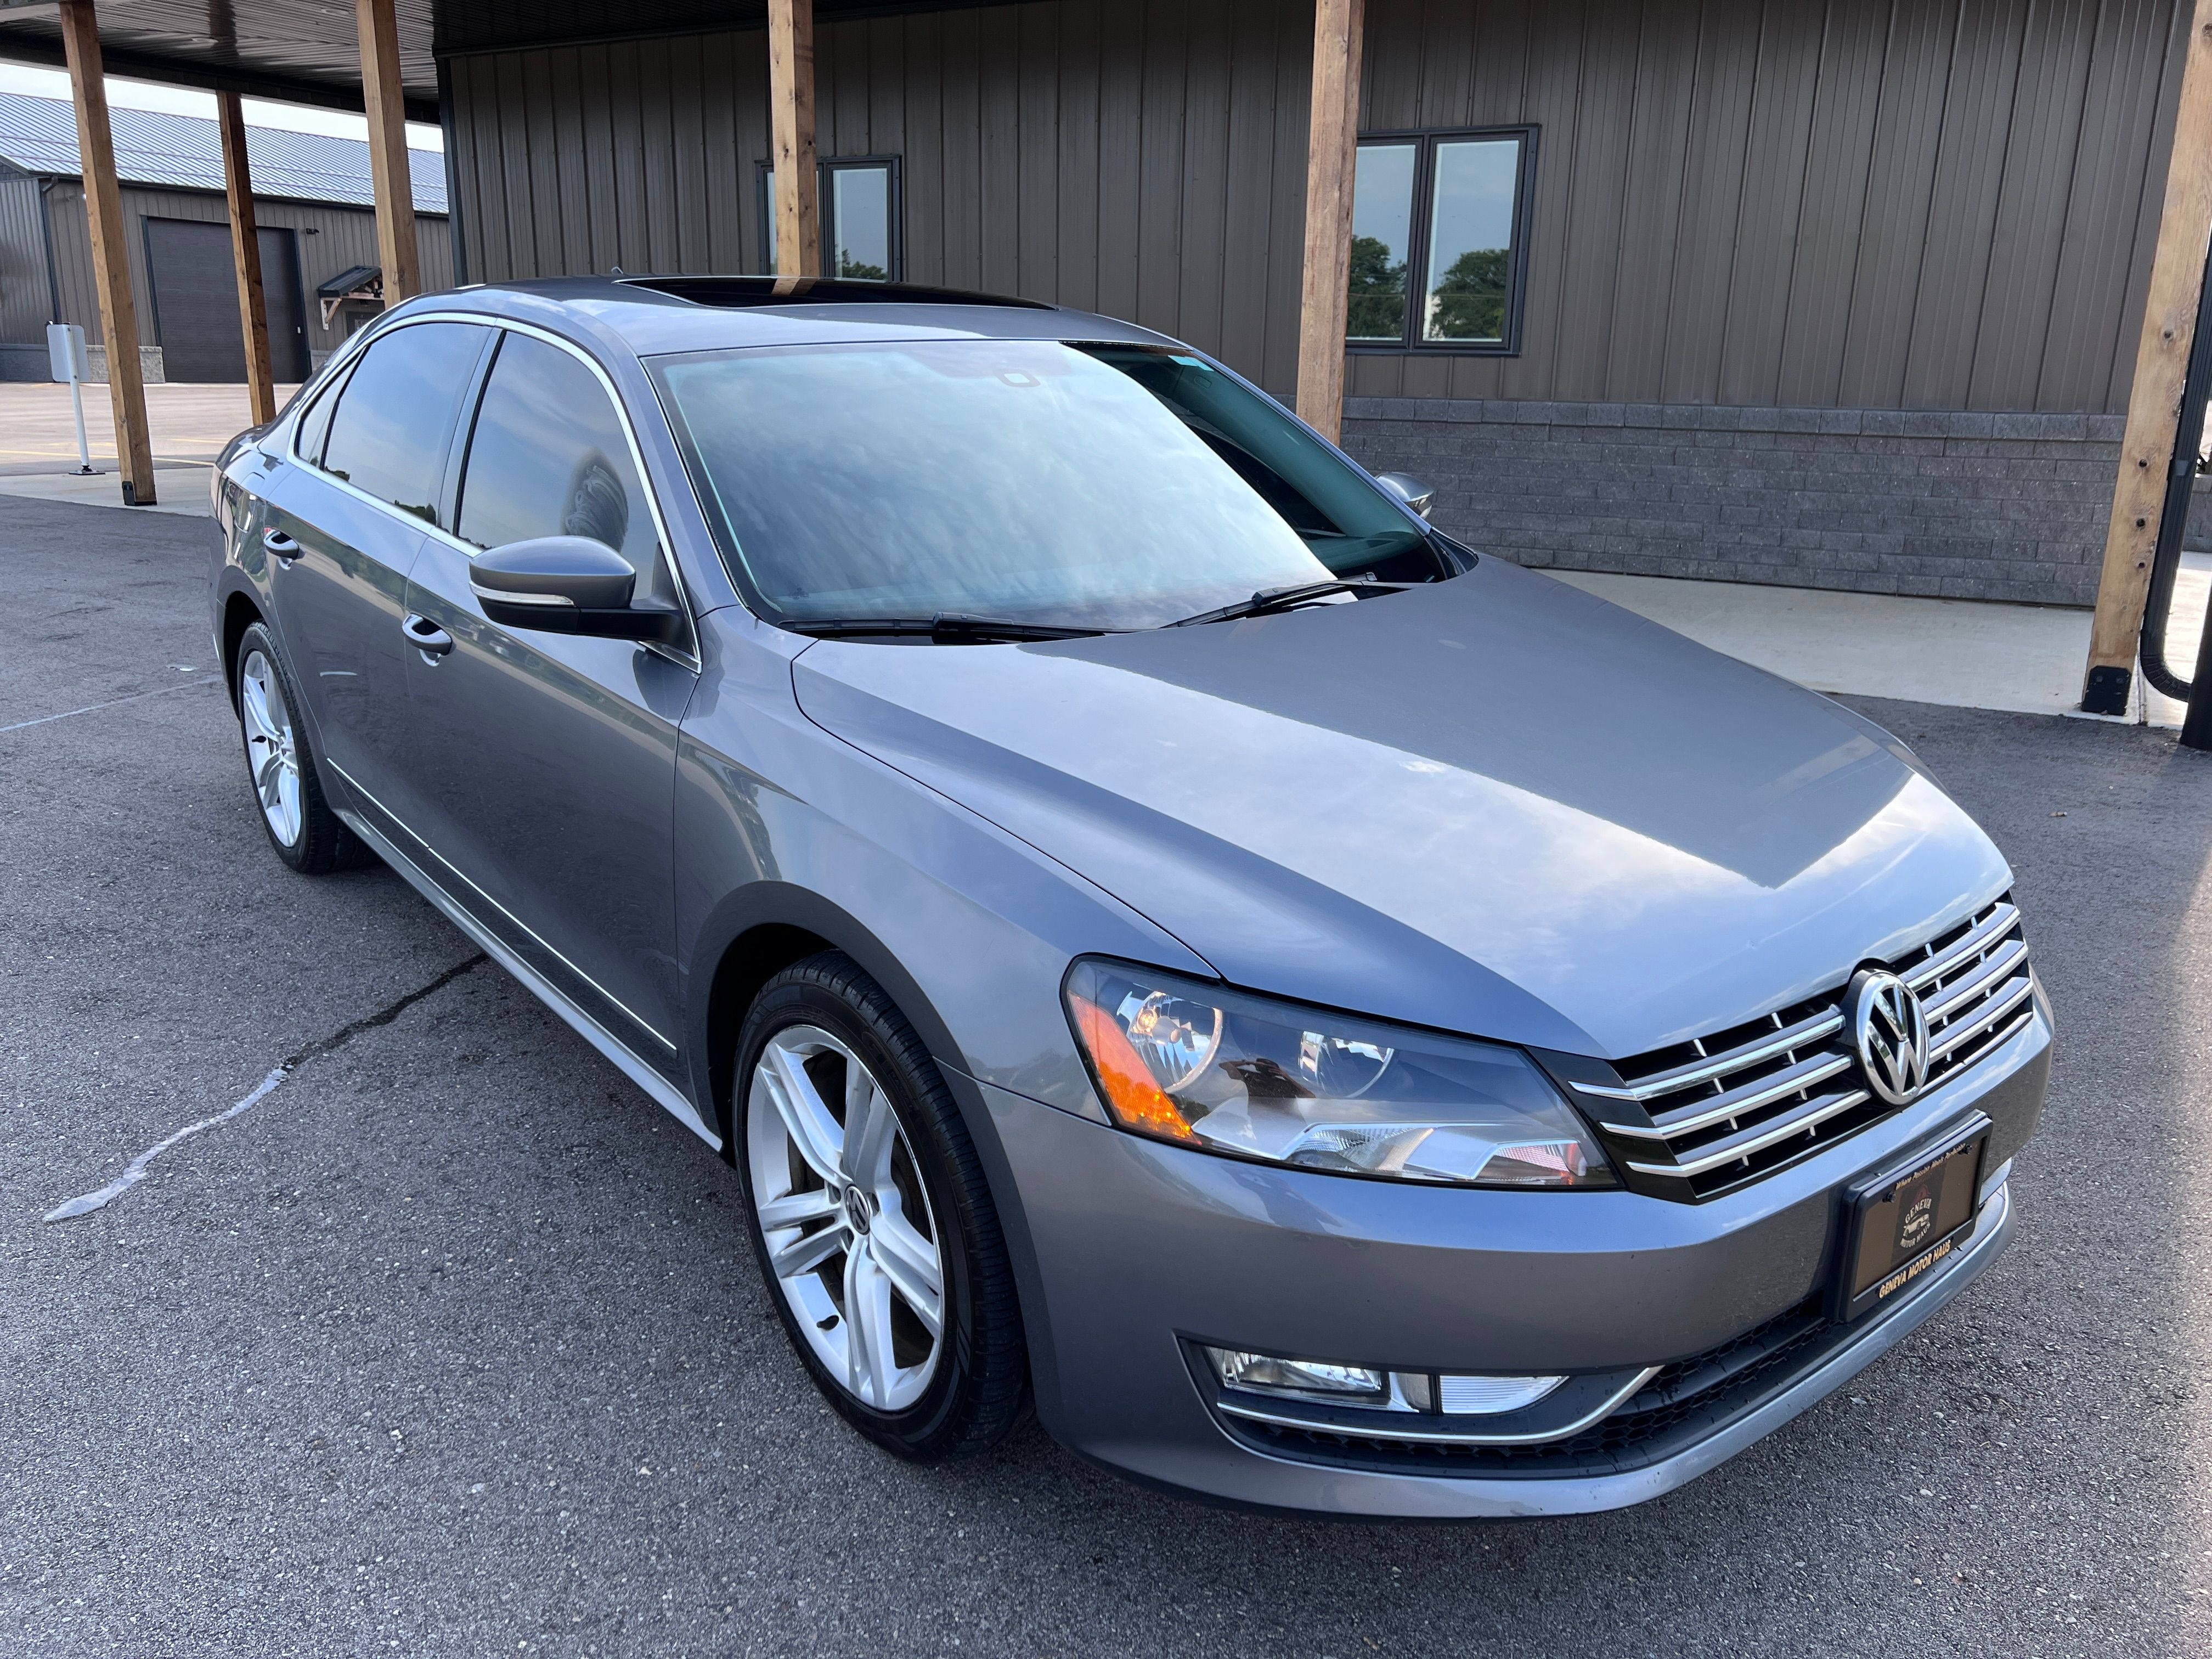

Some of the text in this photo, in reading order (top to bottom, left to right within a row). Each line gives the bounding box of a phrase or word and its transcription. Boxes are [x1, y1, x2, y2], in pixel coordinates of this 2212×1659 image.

[1905, 1198, 1932, 1224] GENEVA
[1900, 1221, 1931, 1249] MOTOR HAUS
[1879, 1239, 1951, 1299] GENEVA MOTOR HAUS
